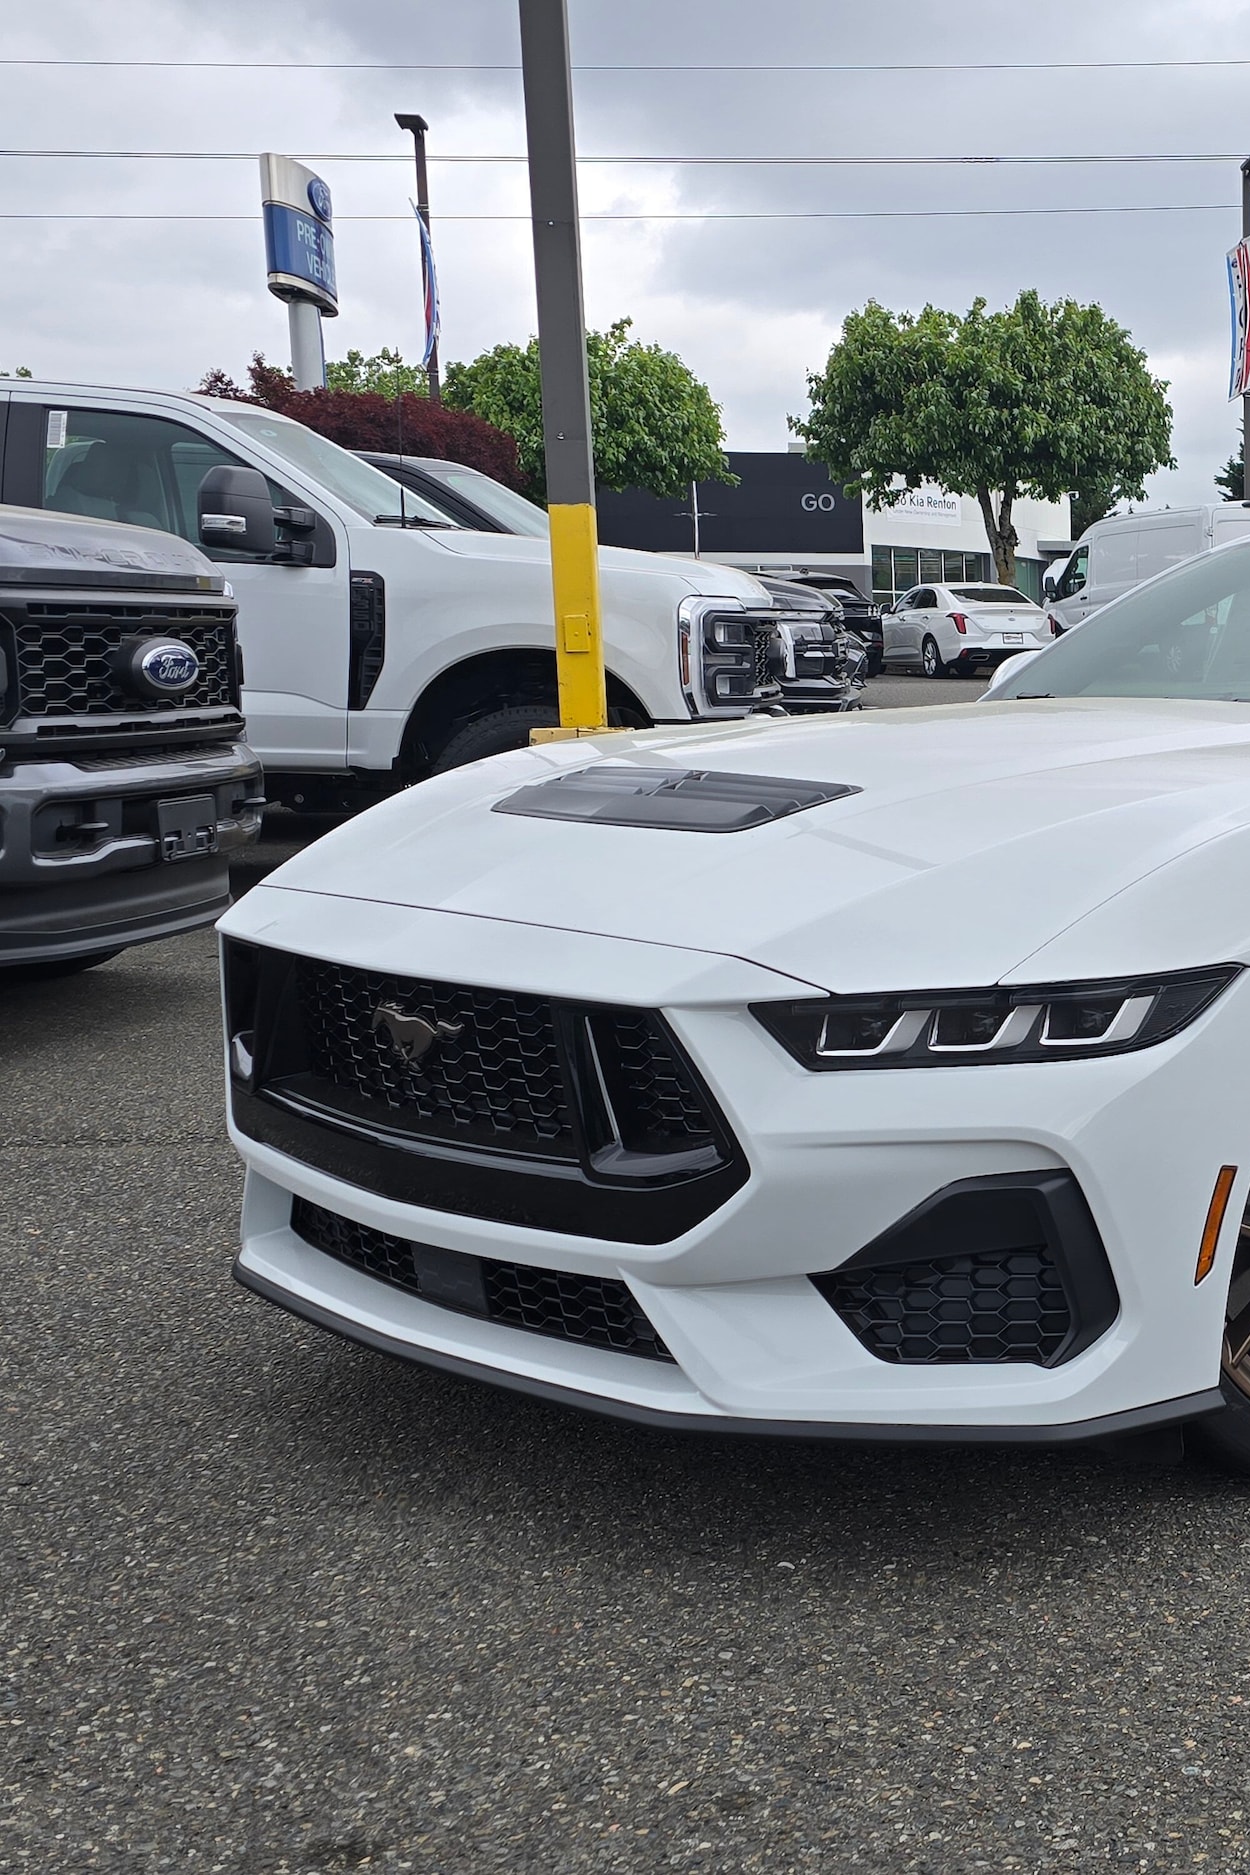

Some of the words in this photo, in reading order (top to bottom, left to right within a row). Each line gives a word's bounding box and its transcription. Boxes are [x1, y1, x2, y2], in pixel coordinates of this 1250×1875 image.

[801, 493, 836, 511] GO
[909, 495, 924, 507] Kia
[927, 496, 957, 510] Renton
[159, 654, 190, 679] Ford
